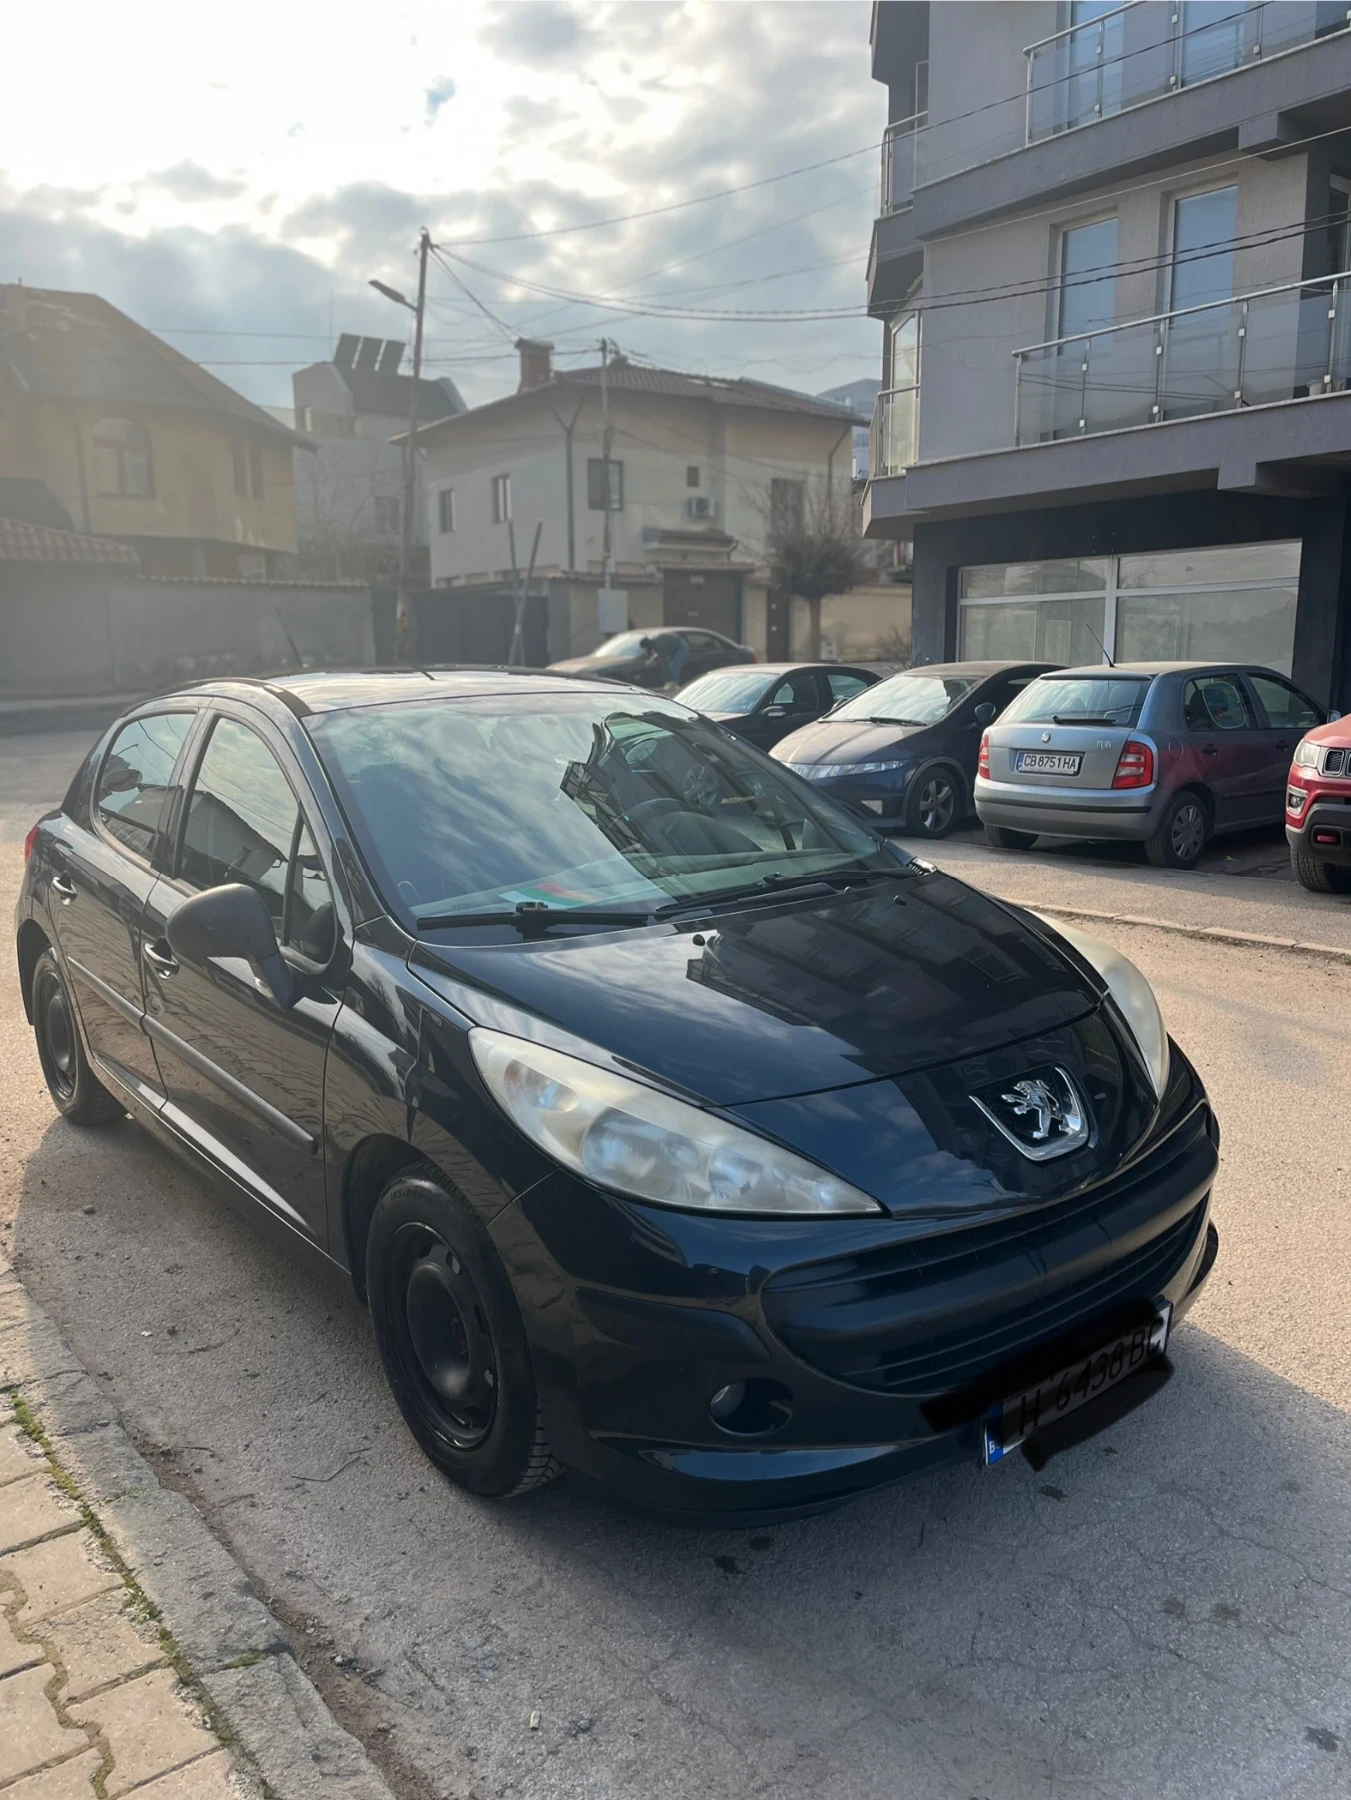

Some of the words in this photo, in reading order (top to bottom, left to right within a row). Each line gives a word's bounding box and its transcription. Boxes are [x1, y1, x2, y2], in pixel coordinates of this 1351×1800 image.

[1024, 755, 1037, 767] CB
[1037, 756, 1061, 769] 8751
[1062, 757, 1076, 770] HA
[1055, 1340, 1124, 1412] 6438
